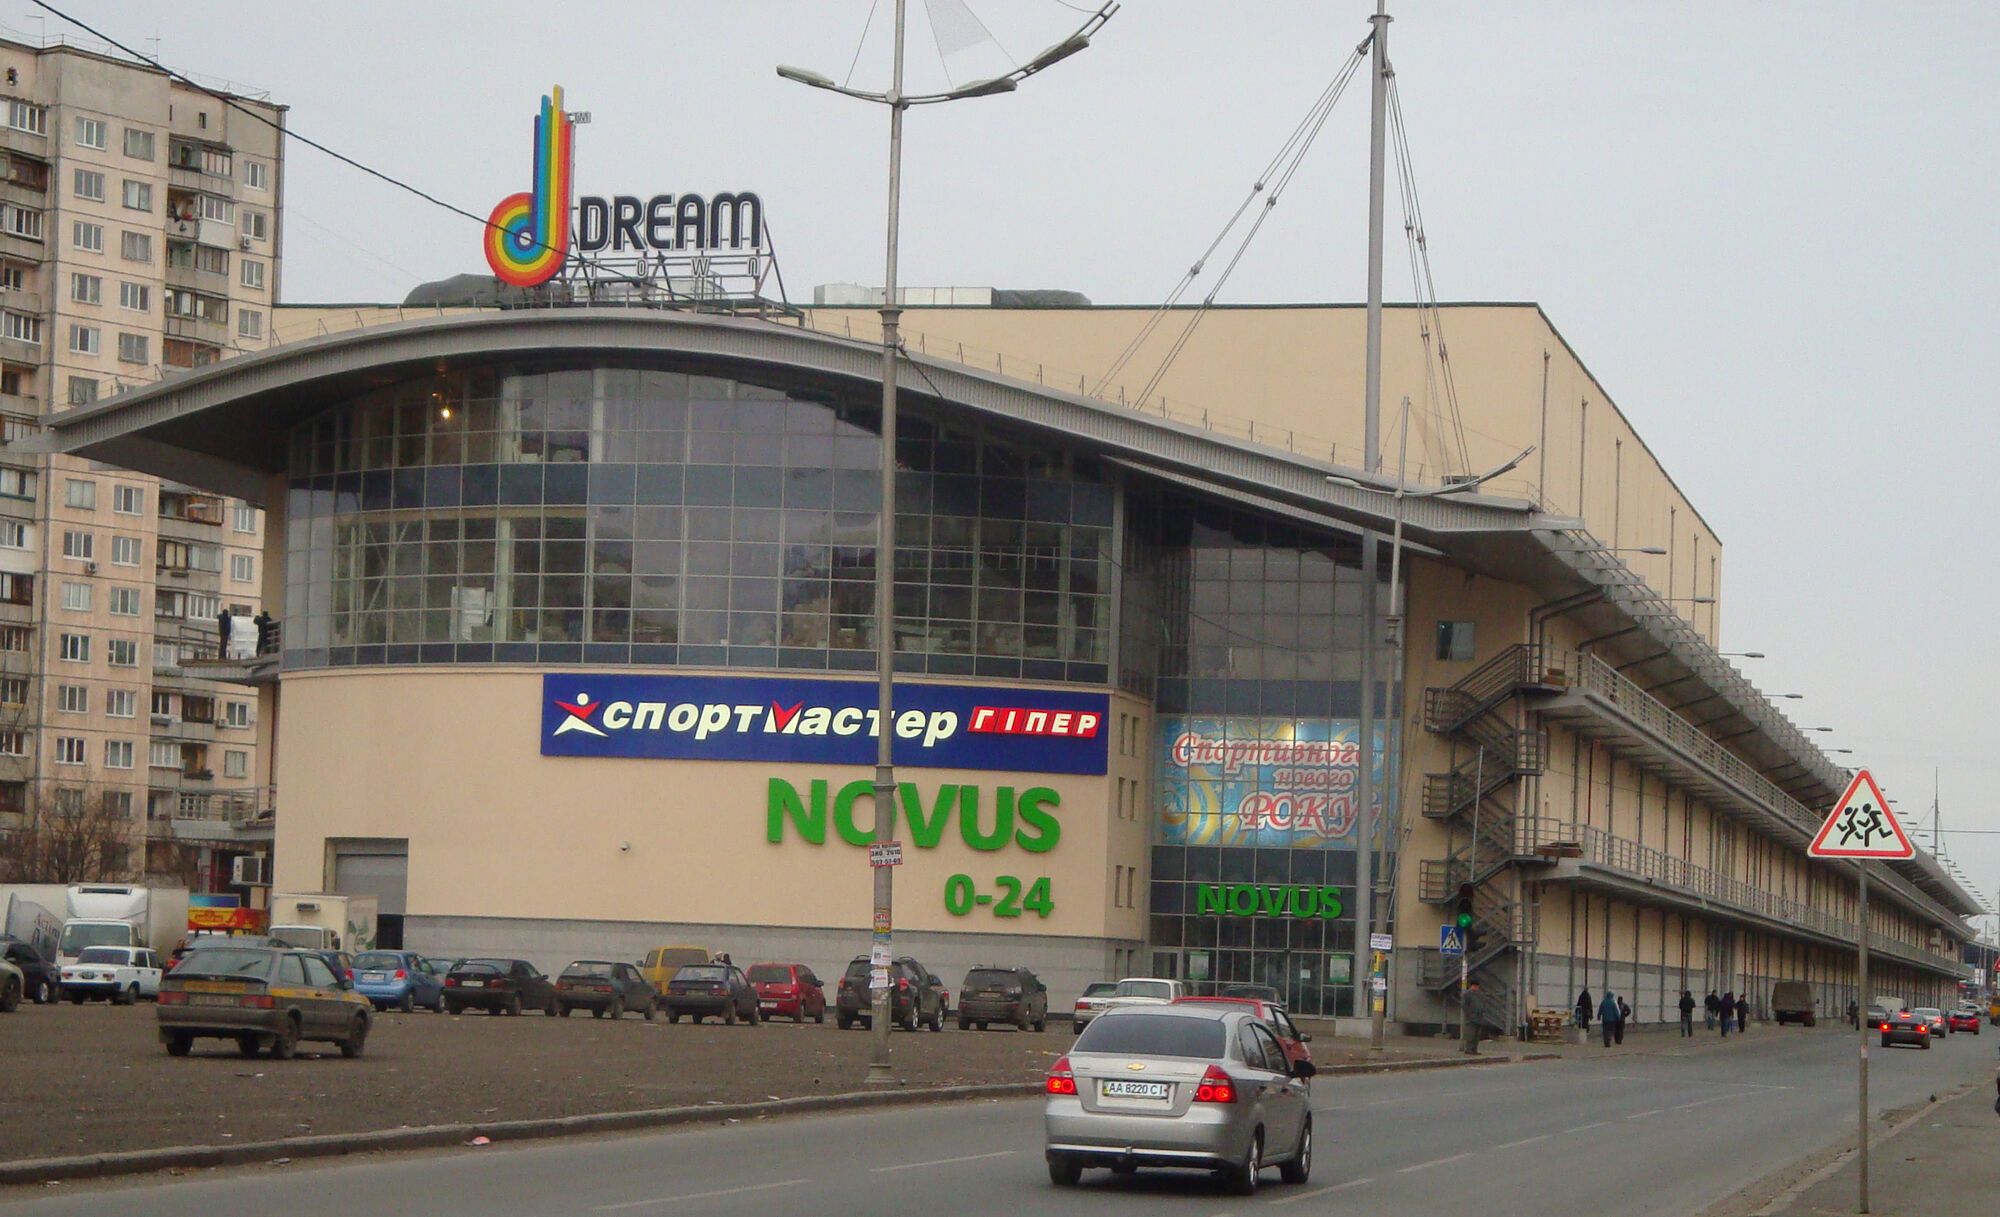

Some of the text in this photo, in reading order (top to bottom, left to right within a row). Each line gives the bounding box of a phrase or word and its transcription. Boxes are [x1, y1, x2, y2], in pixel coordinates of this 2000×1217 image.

[580, 191, 762, 251] DREAM
[974, 709, 1097, 735] ГІПЕР
[1276, 771, 1352, 787] нового
[767, 777, 1062, 853] NOVUS
[944, 873, 1055, 918] 0-24
[1197, 882, 1343, 918] NOVUS
[1125, 1083, 1148, 1094] 8220
